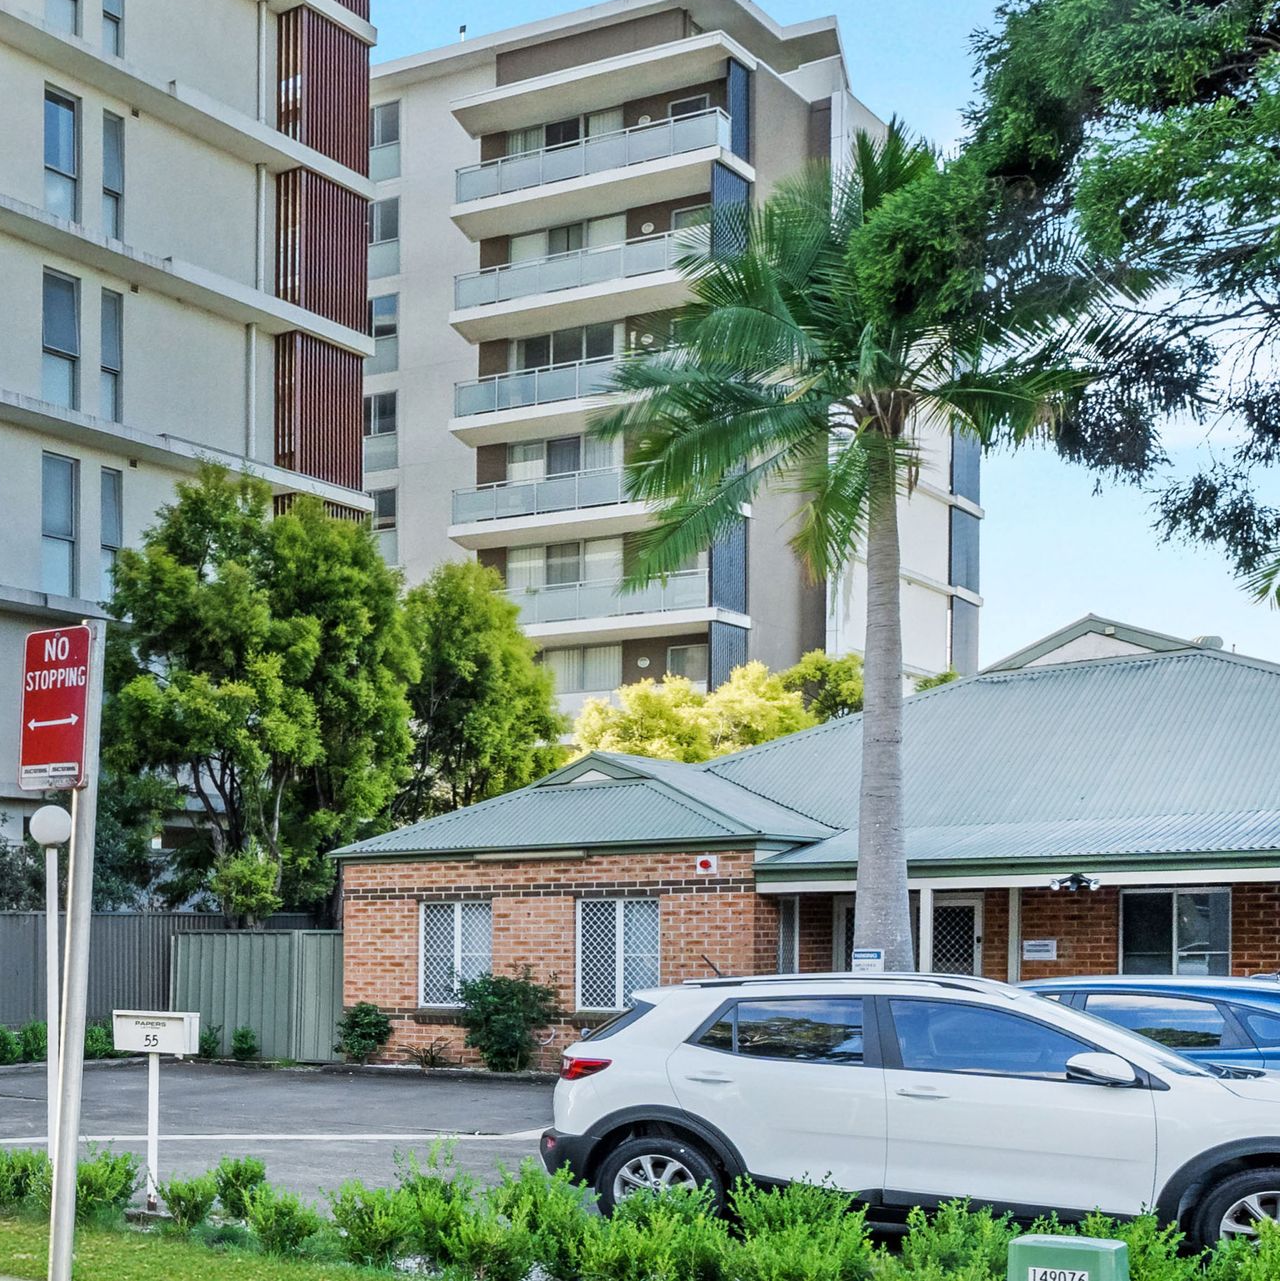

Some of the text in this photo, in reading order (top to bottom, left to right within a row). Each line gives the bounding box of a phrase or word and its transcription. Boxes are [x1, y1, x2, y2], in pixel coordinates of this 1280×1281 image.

[44, 637, 69, 662] NO
[26, 666, 86, 691] STOPPING
[144, 1034, 159, 1047] 55
